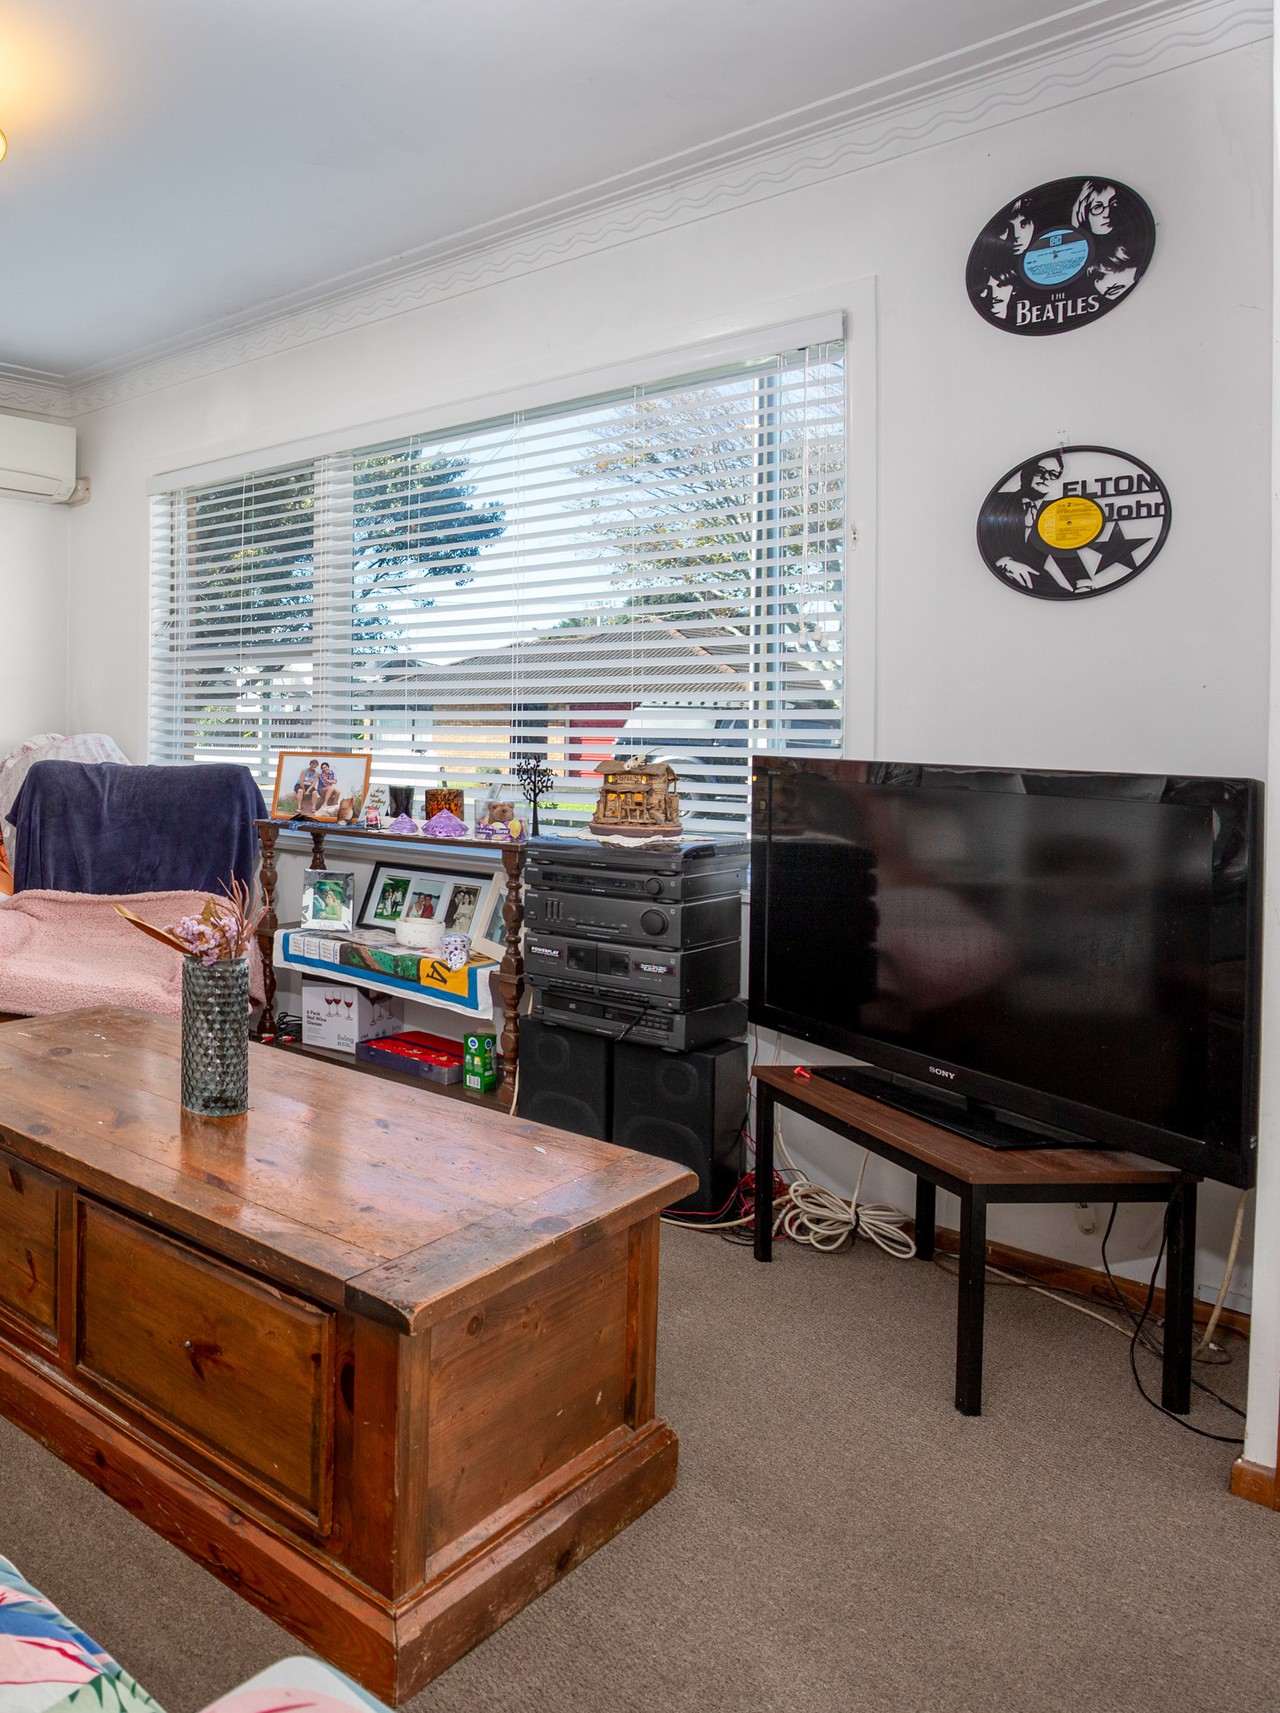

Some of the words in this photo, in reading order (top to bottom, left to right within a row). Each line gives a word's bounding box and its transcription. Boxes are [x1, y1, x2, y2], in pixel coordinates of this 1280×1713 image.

[1016, 294, 1100, 326] BEATLES
[1062, 473, 1161, 499] ELTON
[337, 1034, 355, 1045] living
[929, 1066, 955, 1080] SONY
